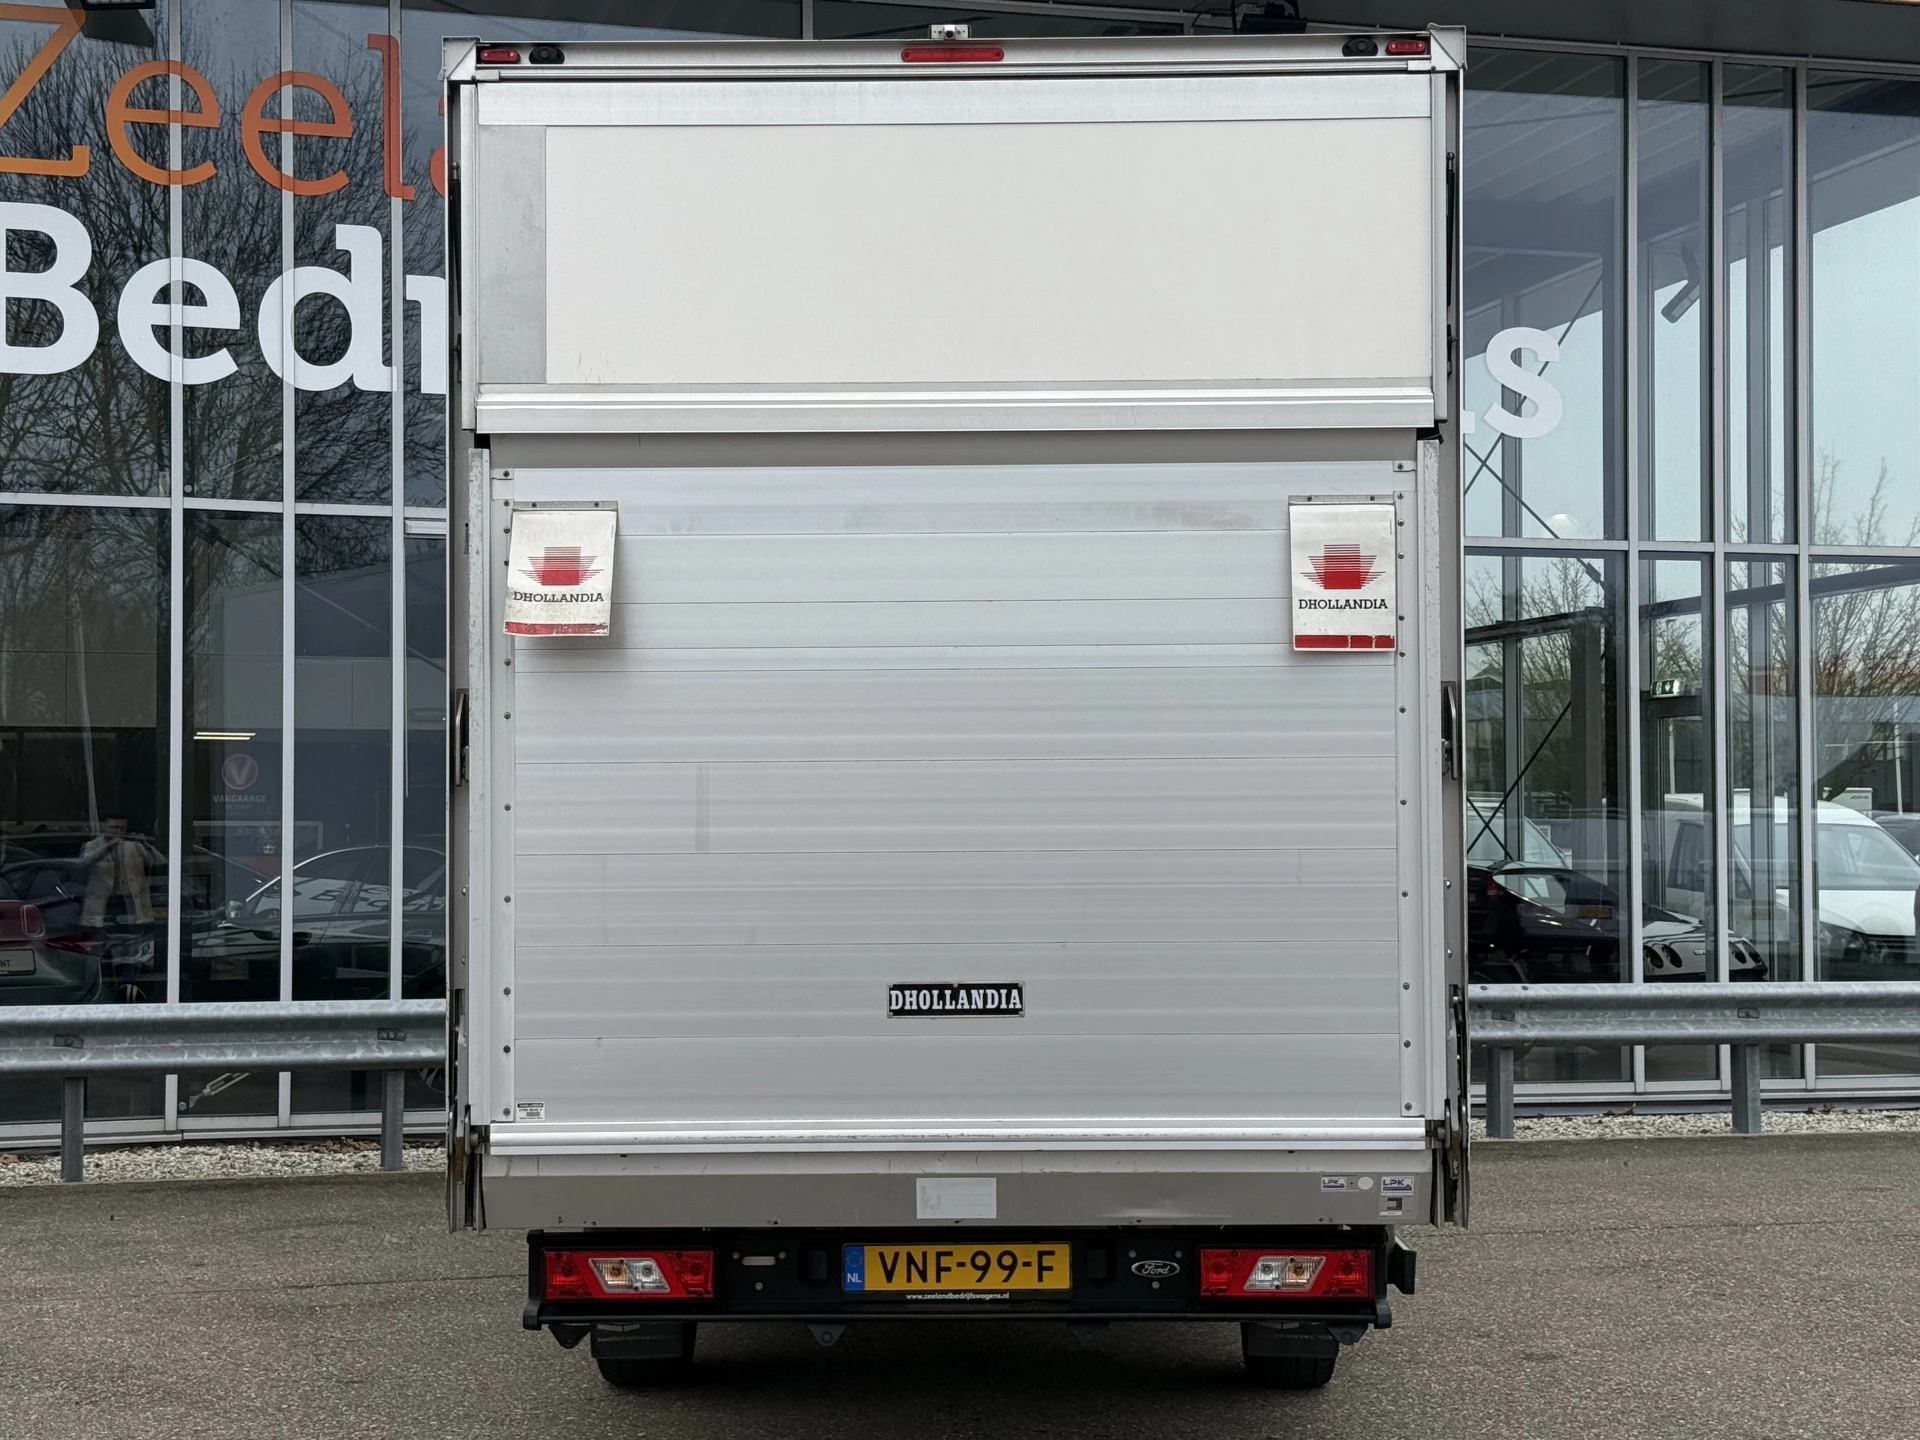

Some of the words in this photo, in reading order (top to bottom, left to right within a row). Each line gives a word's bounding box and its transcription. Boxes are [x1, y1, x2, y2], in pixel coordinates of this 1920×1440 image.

[0, 3, 446, 200] Zeel
[513, 591, 604, 603] DHOLLANDIA
[1298, 599, 1389, 610] DHOLLANDIA
[890, 989, 1022, 1010] DHOLLANDIA
[877, 1249, 1057, 1284] VNF-99-F
[1141, 1262, 1171, 1276] Ford
[846, 1273, 862, 1284] NL
[905, 1292, 1010, 1301] www.zeelandbedrijfswagens.nl
